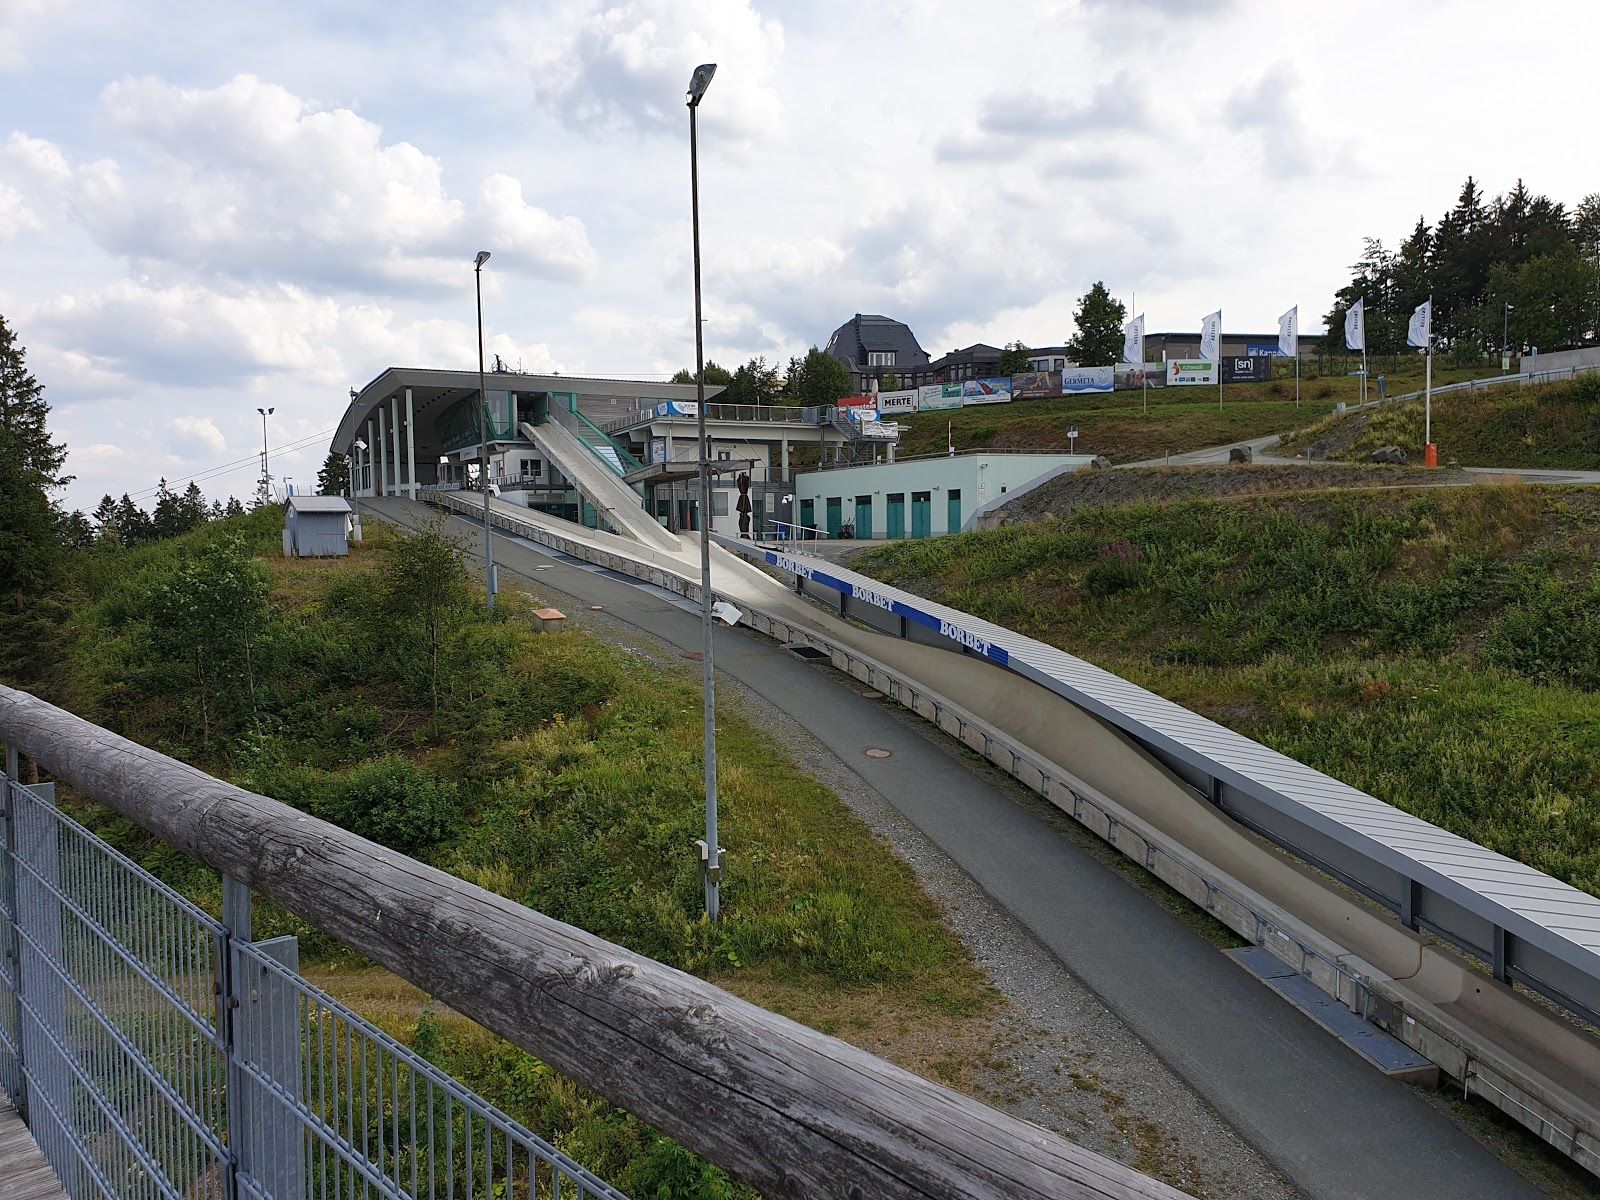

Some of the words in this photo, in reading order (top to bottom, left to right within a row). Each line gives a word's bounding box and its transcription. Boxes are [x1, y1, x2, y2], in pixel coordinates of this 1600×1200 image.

[1064, 377, 1095, 385] GERMETA
[884, 397, 911, 407] MERTE
[775, 556, 814, 580] BORBET
[852, 585, 894, 611] BORBET
[940, 620, 992, 656] BORBET
